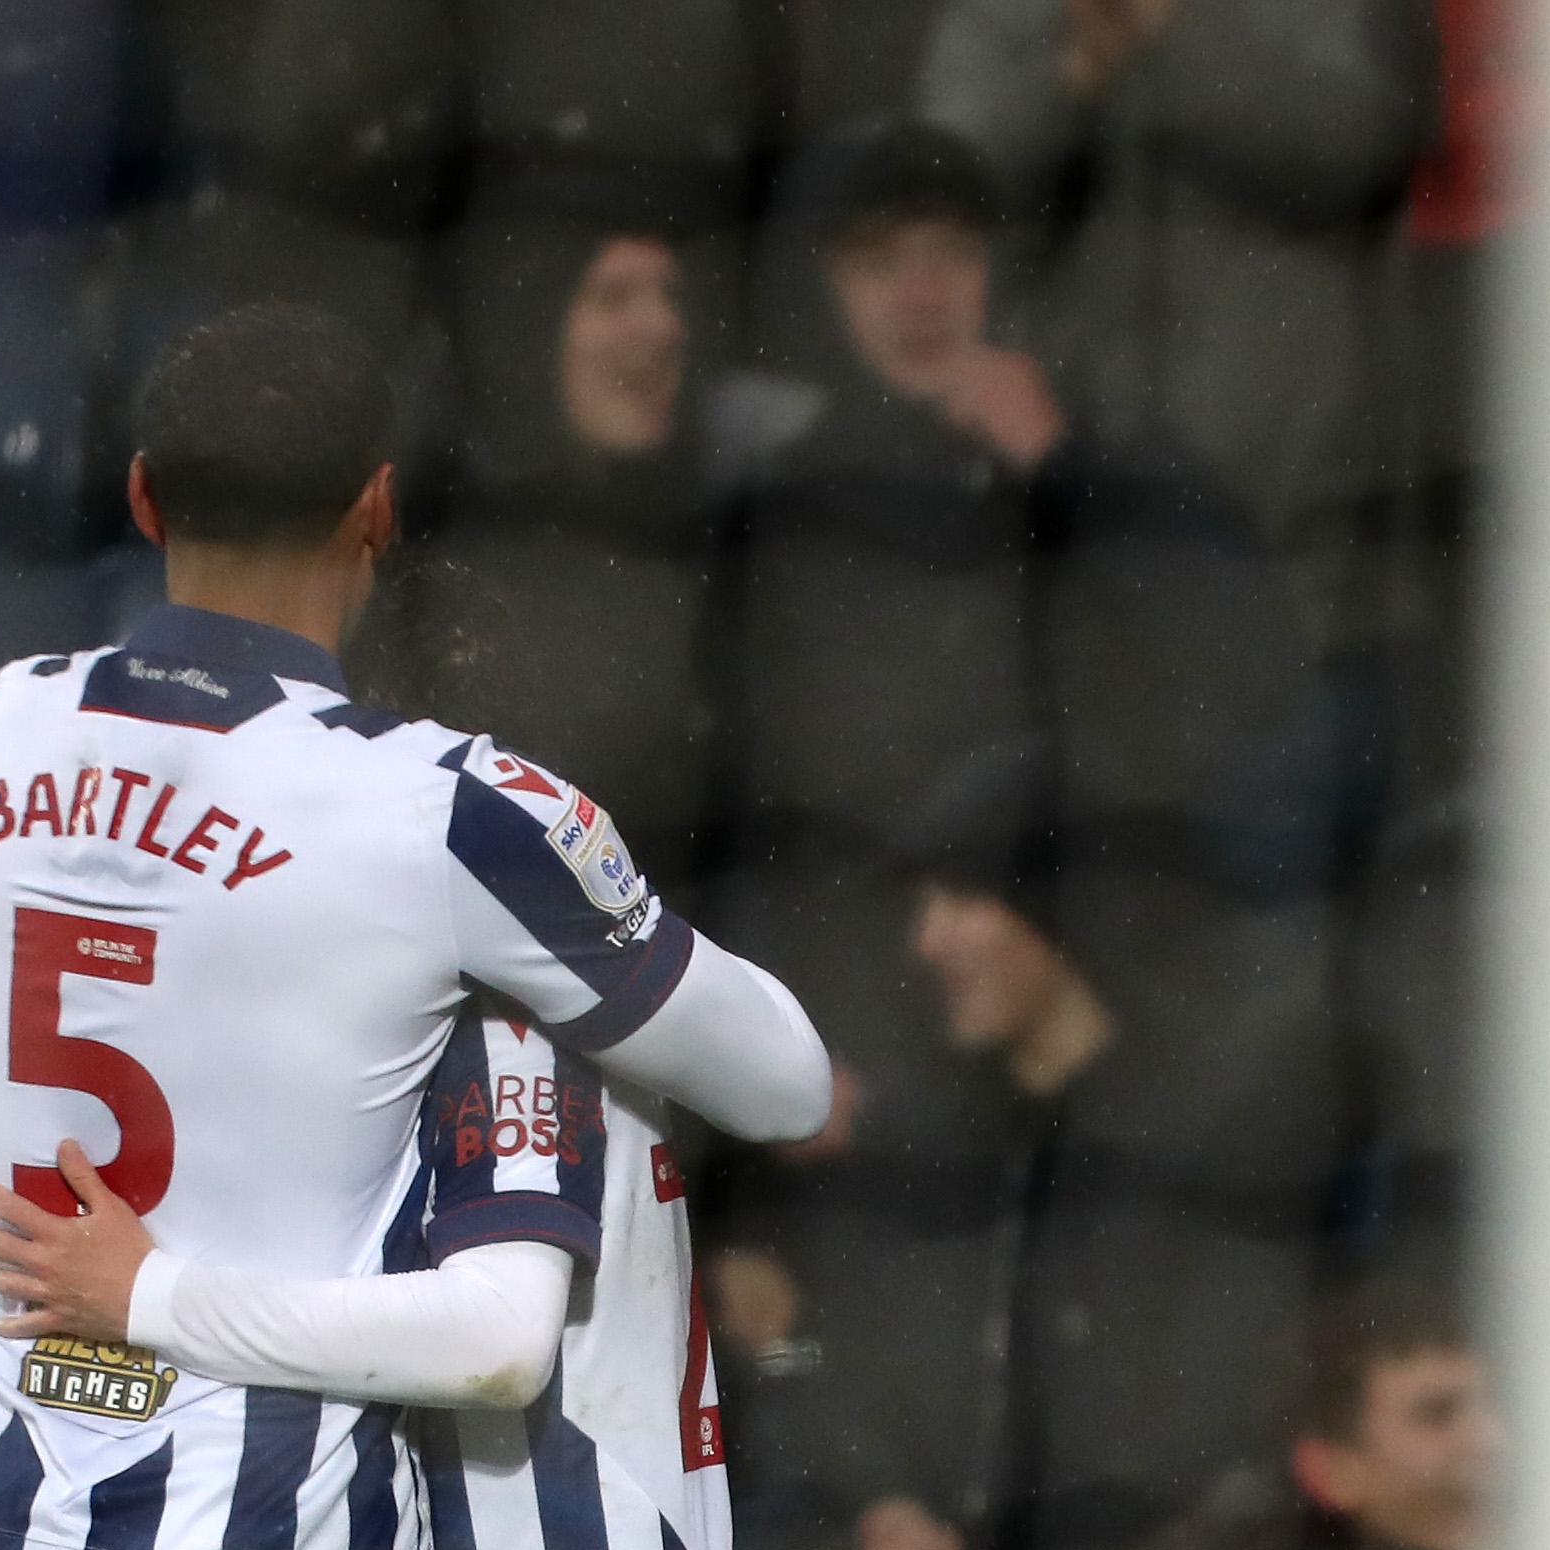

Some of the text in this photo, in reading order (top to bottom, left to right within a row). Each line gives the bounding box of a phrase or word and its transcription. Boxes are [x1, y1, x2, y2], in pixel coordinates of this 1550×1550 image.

[561, 821, 584, 850] sky
[9, 907, 176, 1218] 5
[456, 1118, 582, 1168] BOSS
[29, 1364, 148, 1411] RICHES
